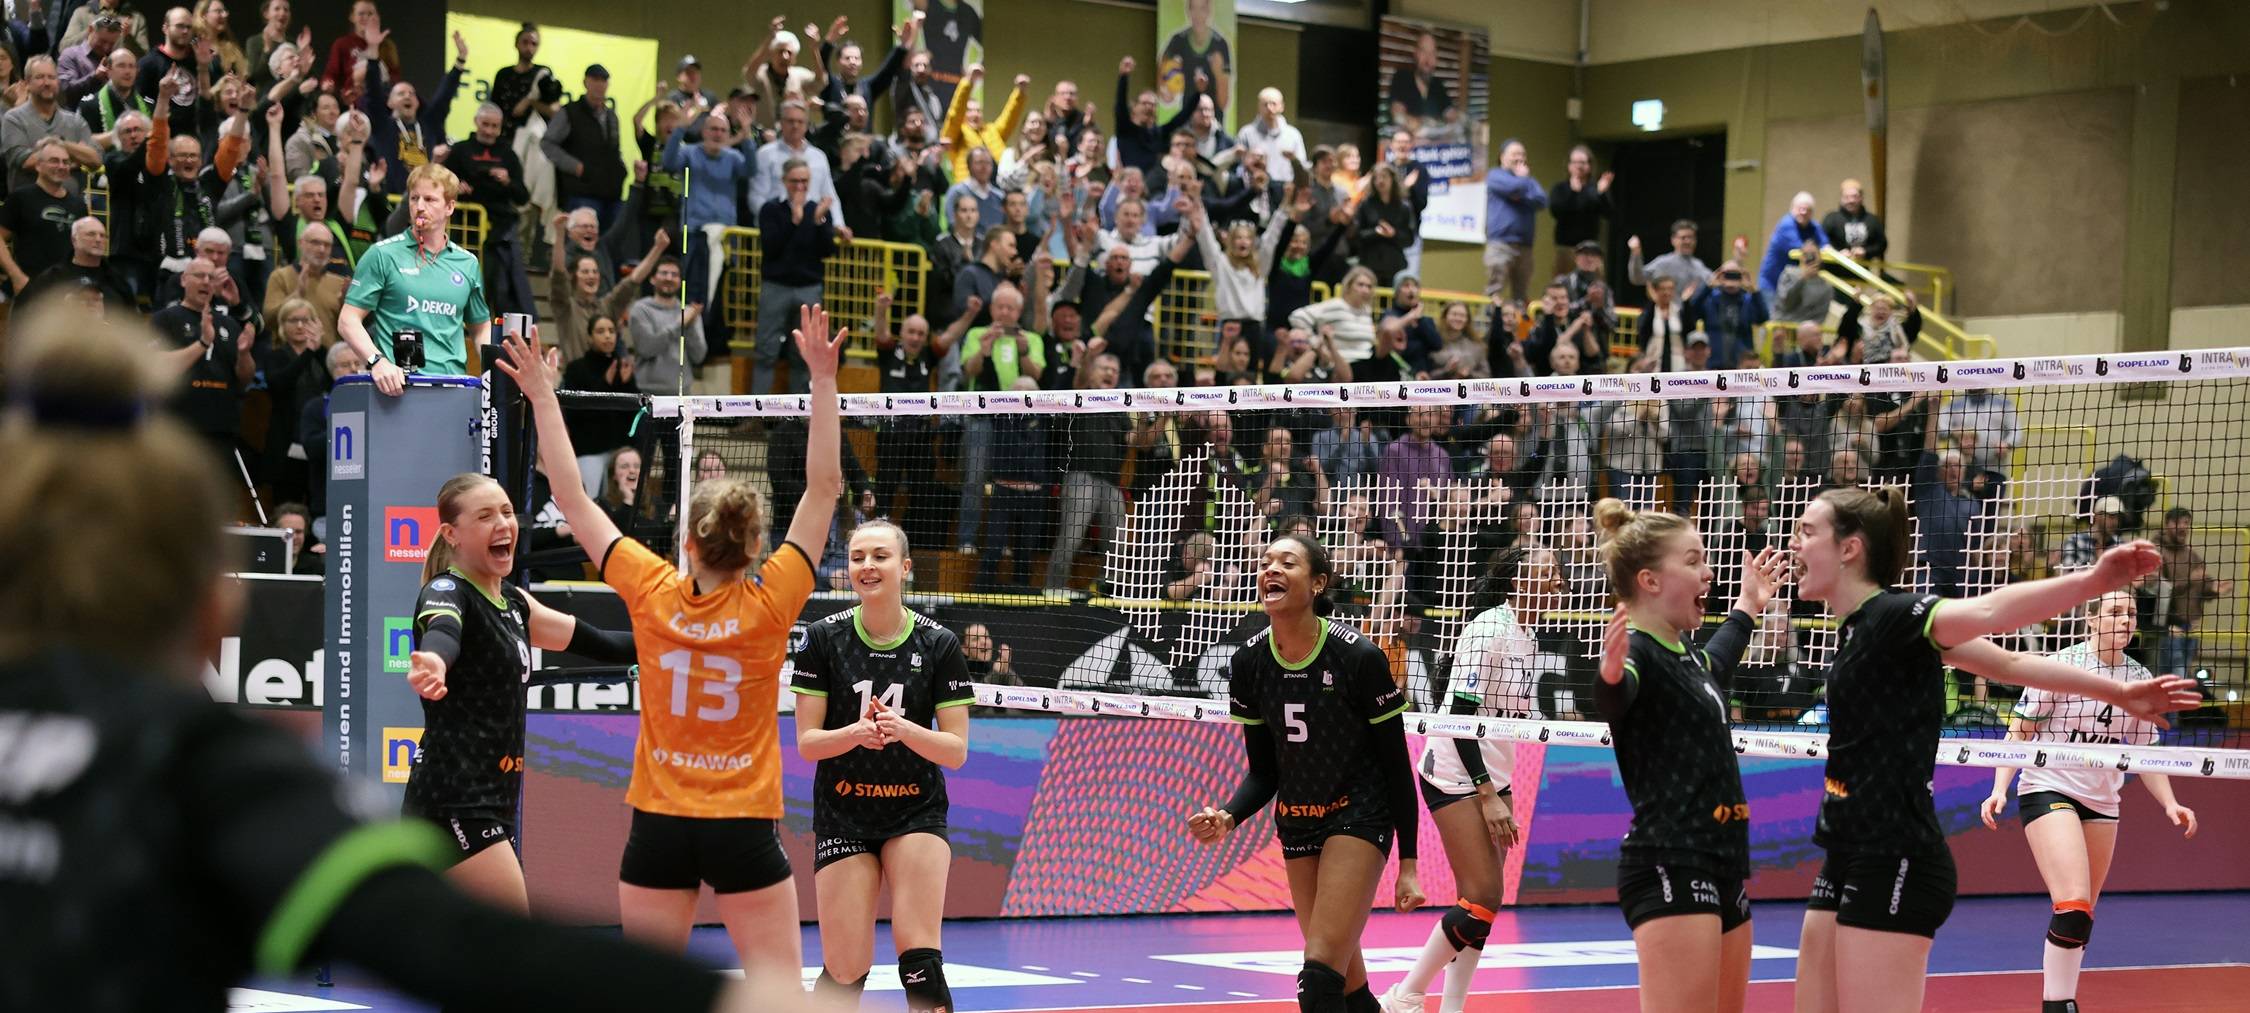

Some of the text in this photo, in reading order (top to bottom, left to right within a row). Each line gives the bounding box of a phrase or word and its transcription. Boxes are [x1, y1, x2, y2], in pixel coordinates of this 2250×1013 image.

[421, 300, 457, 316] DEKRA
[1414, 386, 1451, 394] COPELAND
[1536, 382, 1576, 390] COPELAND
[1667, 378, 1709, 386] COPELAND
[1807, 372, 1851, 381] COPELAND
[1956, 366, 2005, 376] COPELAND
[2117, 359, 2170, 368] COPELAND
[2201, 352, 2250, 368] INTRAVI
[481, 369, 492, 475] DIRKRA
[335, 425, 353, 460] n
[390, 517, 420, 546] n
[389, 548, 429, 558] nessel
[339, 504, 352, 644] Immobilien
[668, 611, 741, 640] CSAR
[339, 651, 351, 698] und
[517, 640, 531, 684] 9
[659, 649, 743, 722] 13
[852, 679, 906, 721] 14
[1284, 703, 1309, 743] 5
[2097, 703, 2113, 728] 4
[1207, 708, 1231, 716] COPEL
[1978, 751, 2027, 760] COPELAND
[2140, 758, 2193, 768] COPELAND
[671, 752, 752, 770] STAWAG
[854, 783, 920, 797] STAWAG
